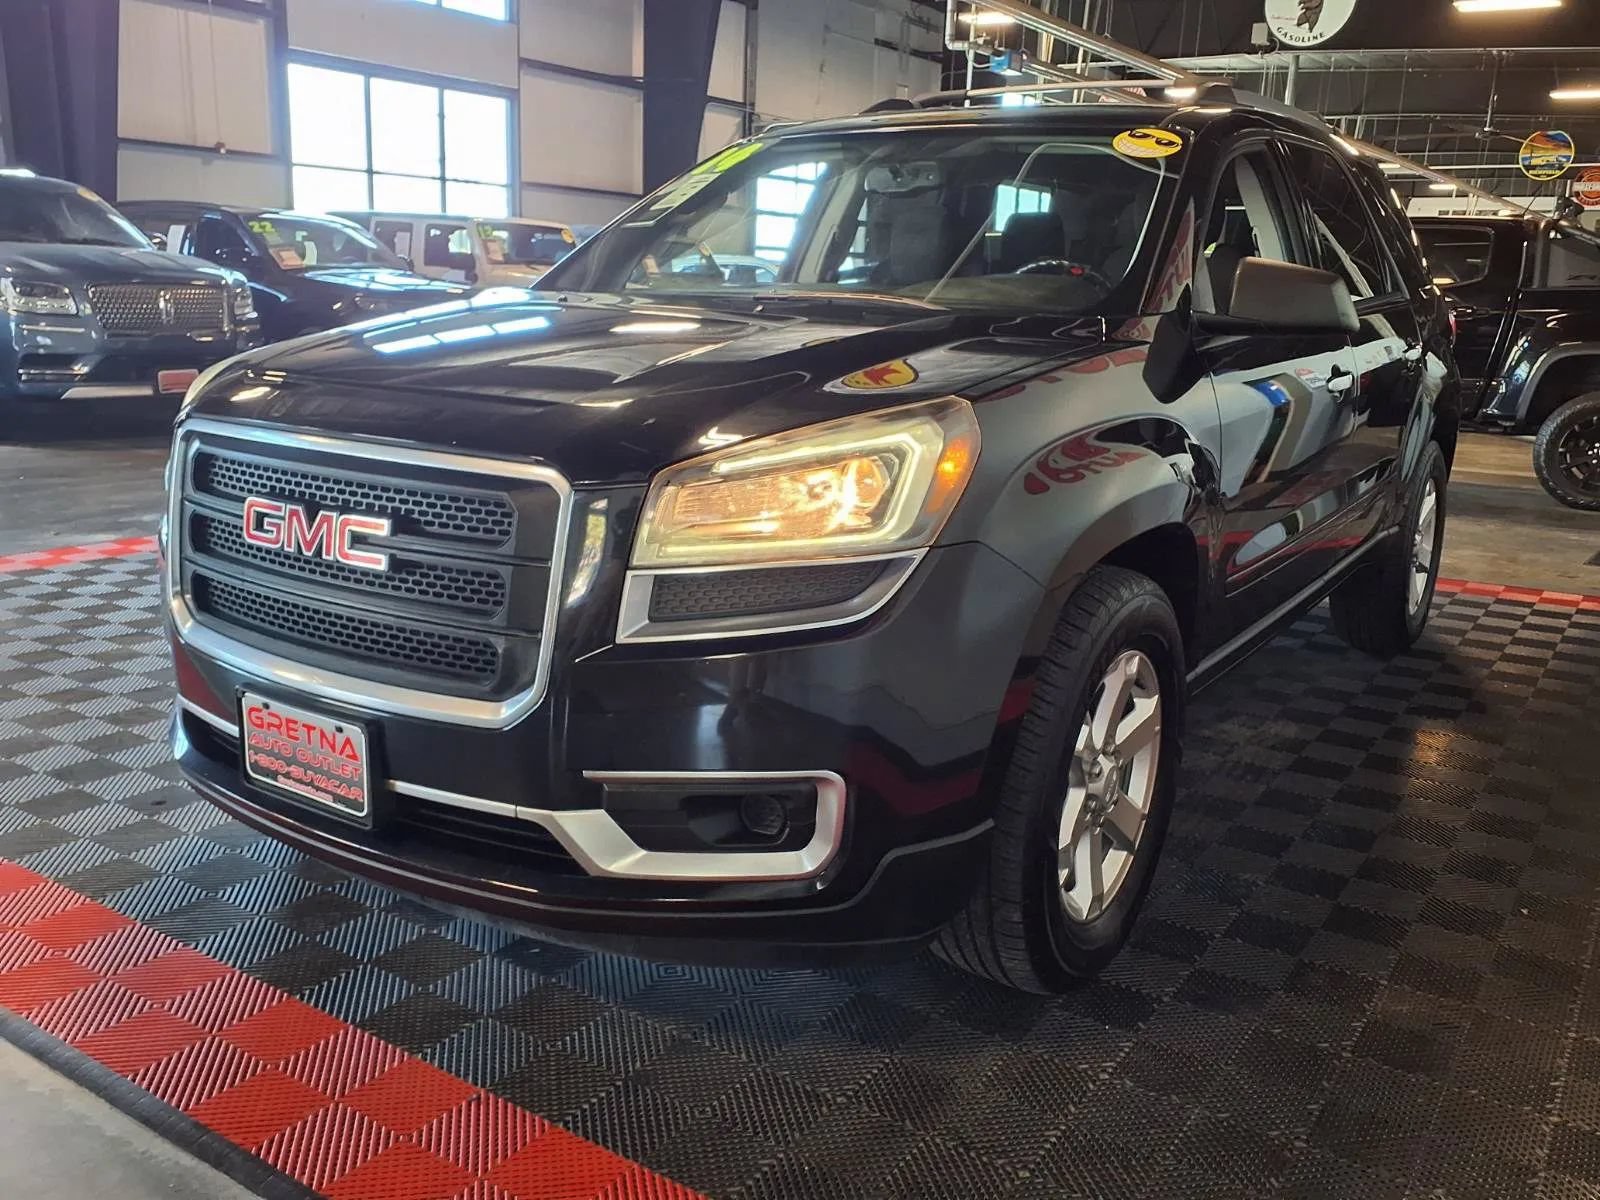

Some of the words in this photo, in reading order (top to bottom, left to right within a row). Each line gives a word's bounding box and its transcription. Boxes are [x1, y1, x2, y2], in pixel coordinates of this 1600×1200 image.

[1277, 26, 1325, 43] GASOLINE
[243, 496, 391, 571] GMC
[247, 705, 361, 763] GRETNA
[249, 732, 293, 757] AUTO
[296, 748, 361, 781] OUTLET
